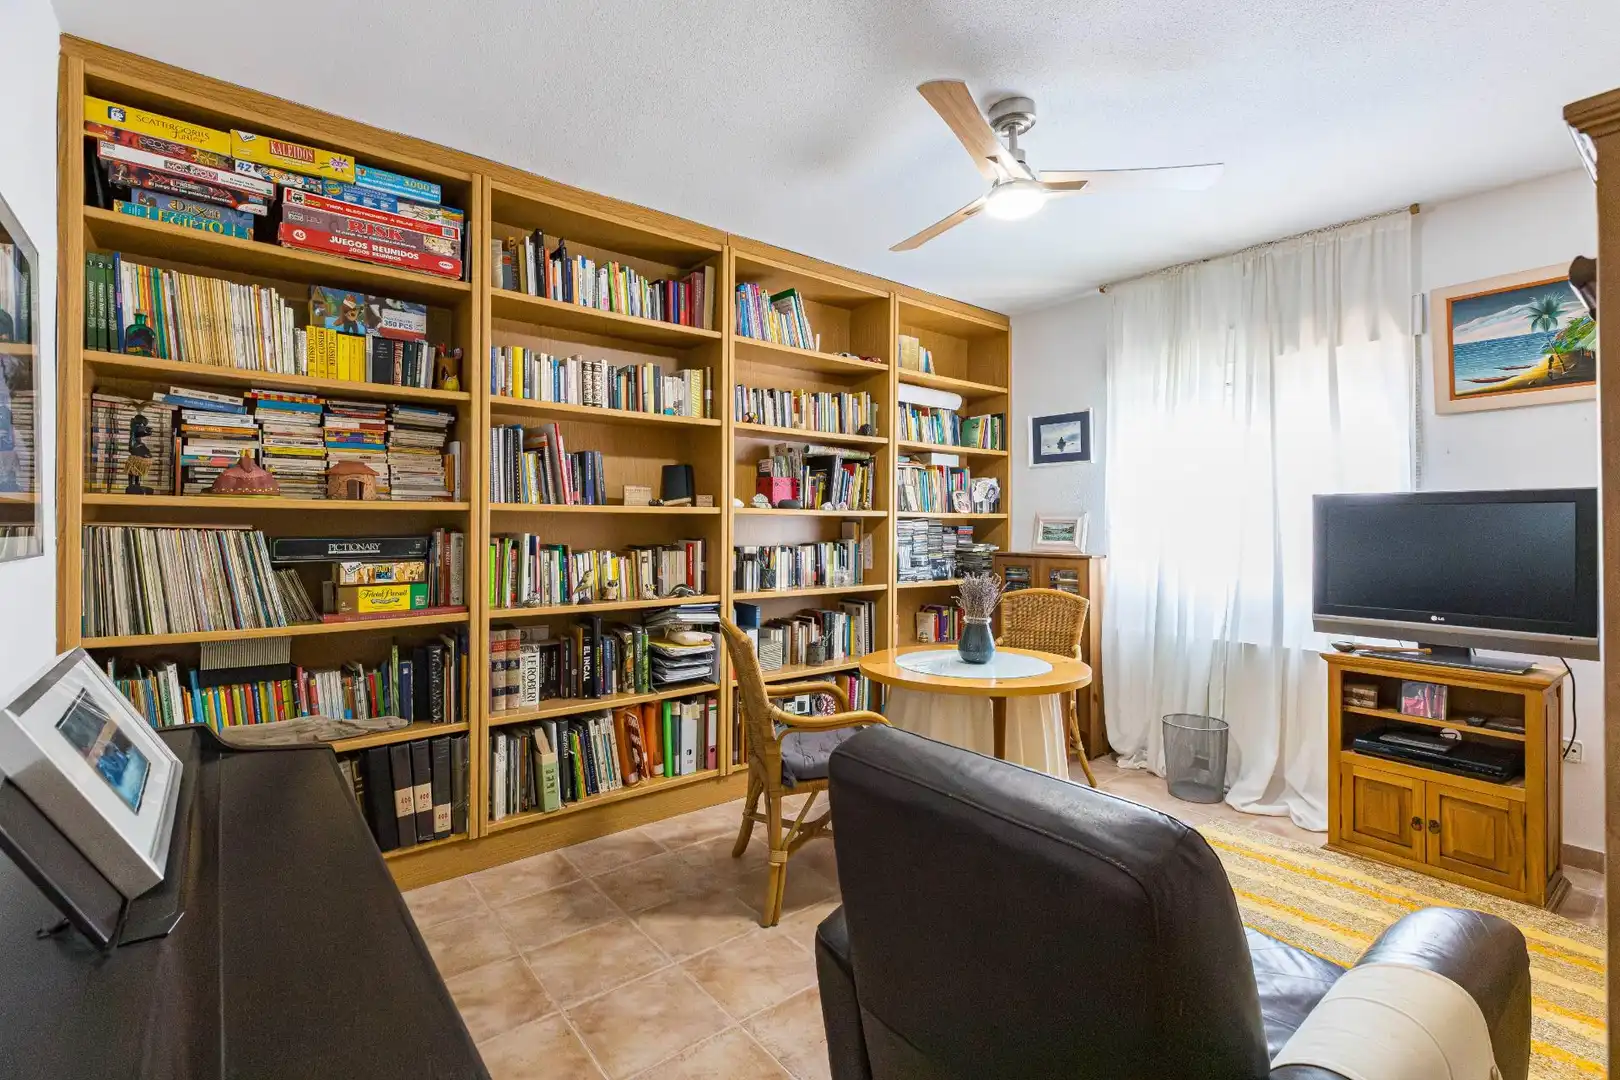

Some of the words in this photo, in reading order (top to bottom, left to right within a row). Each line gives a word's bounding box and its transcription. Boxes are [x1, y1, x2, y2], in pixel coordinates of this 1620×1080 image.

[270, 141, 314, 162] KALEIDOS
[166, 162, 217, 181] MONOPOLY
[237, 162, 252, 173] 42
[347, 218, 405, 243] RISK
[329, 235, 368, 250] JUEGOS
[371, 244, 420, 261] REUNIDOS
[384, 319, 398, 328] 350
[398, 322, 414, 331] PCS
[328, 542, 381, 551] PICTIONARY
[358, 588, 384, 600] Trivial
[384, 586, 408, 600] Pursuit
[583, 645, 591, 658] EL
[583, 658, 591, 682] INCAL
[526, 666, 537, 702] ROBERT
